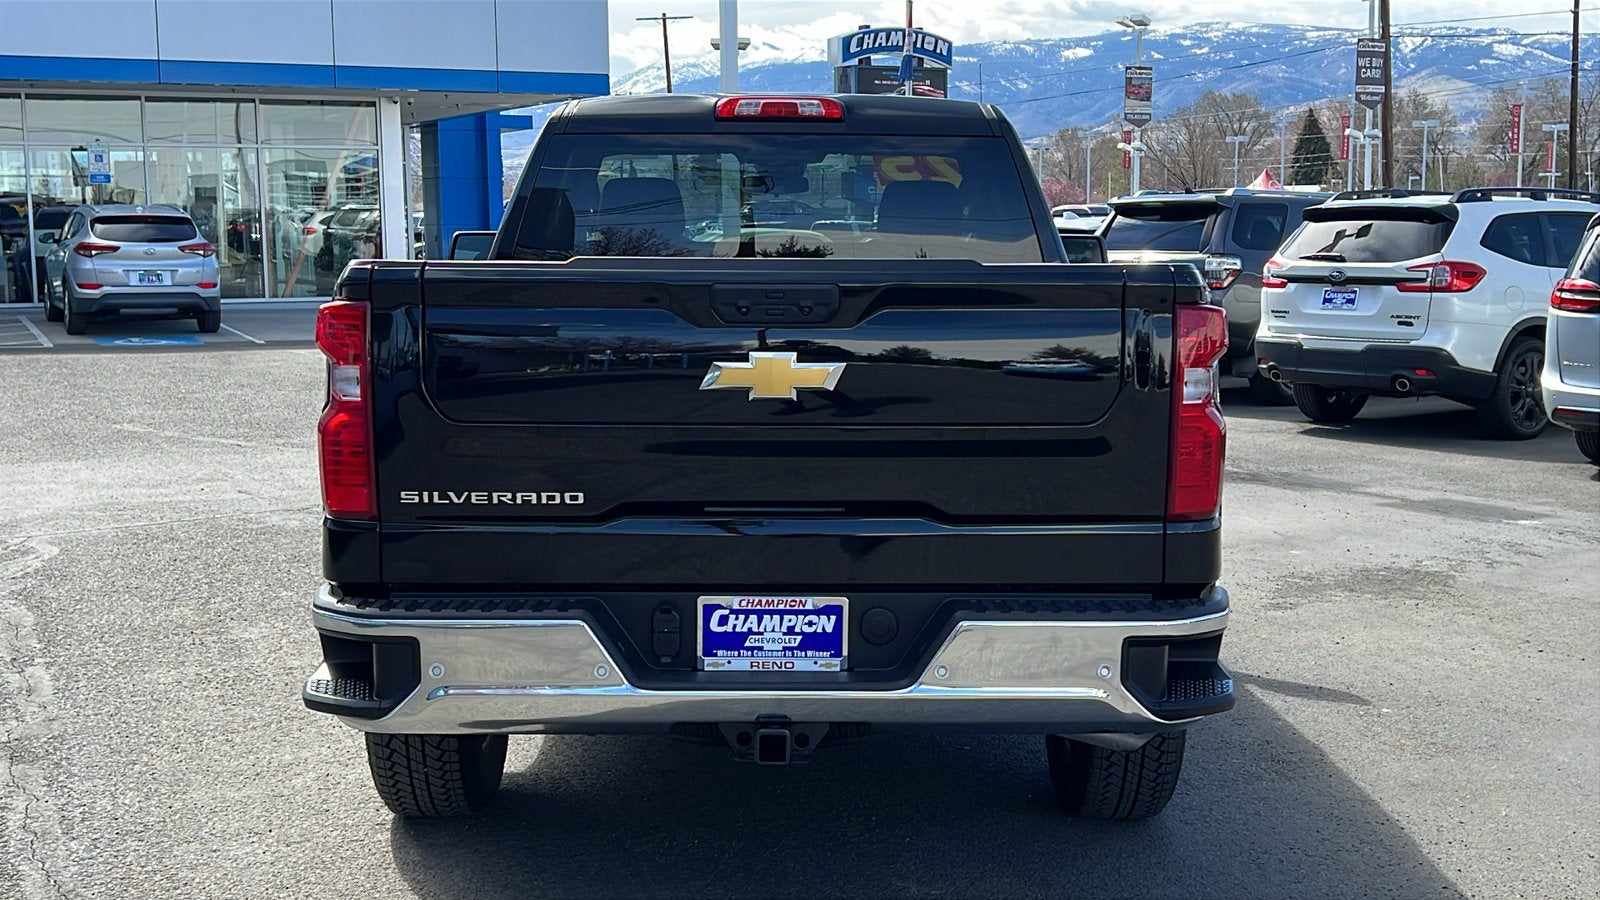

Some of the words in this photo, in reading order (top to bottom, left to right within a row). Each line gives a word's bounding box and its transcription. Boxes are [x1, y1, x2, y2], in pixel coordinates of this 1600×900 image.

[1358, 57, 1370, 67] WE
[1372, 57, 1384, 67] BUY
[1361, 68, 1382, 78] CARS!
[400, 491, 585, 504] SILVERADO
[738, 599, 808, 608] CHAMPION
[709, 609, 837, 633] CHAMPION
[748, 636, 798, 645] CHEVROLET
[750, 661, 795, 670] RENO
